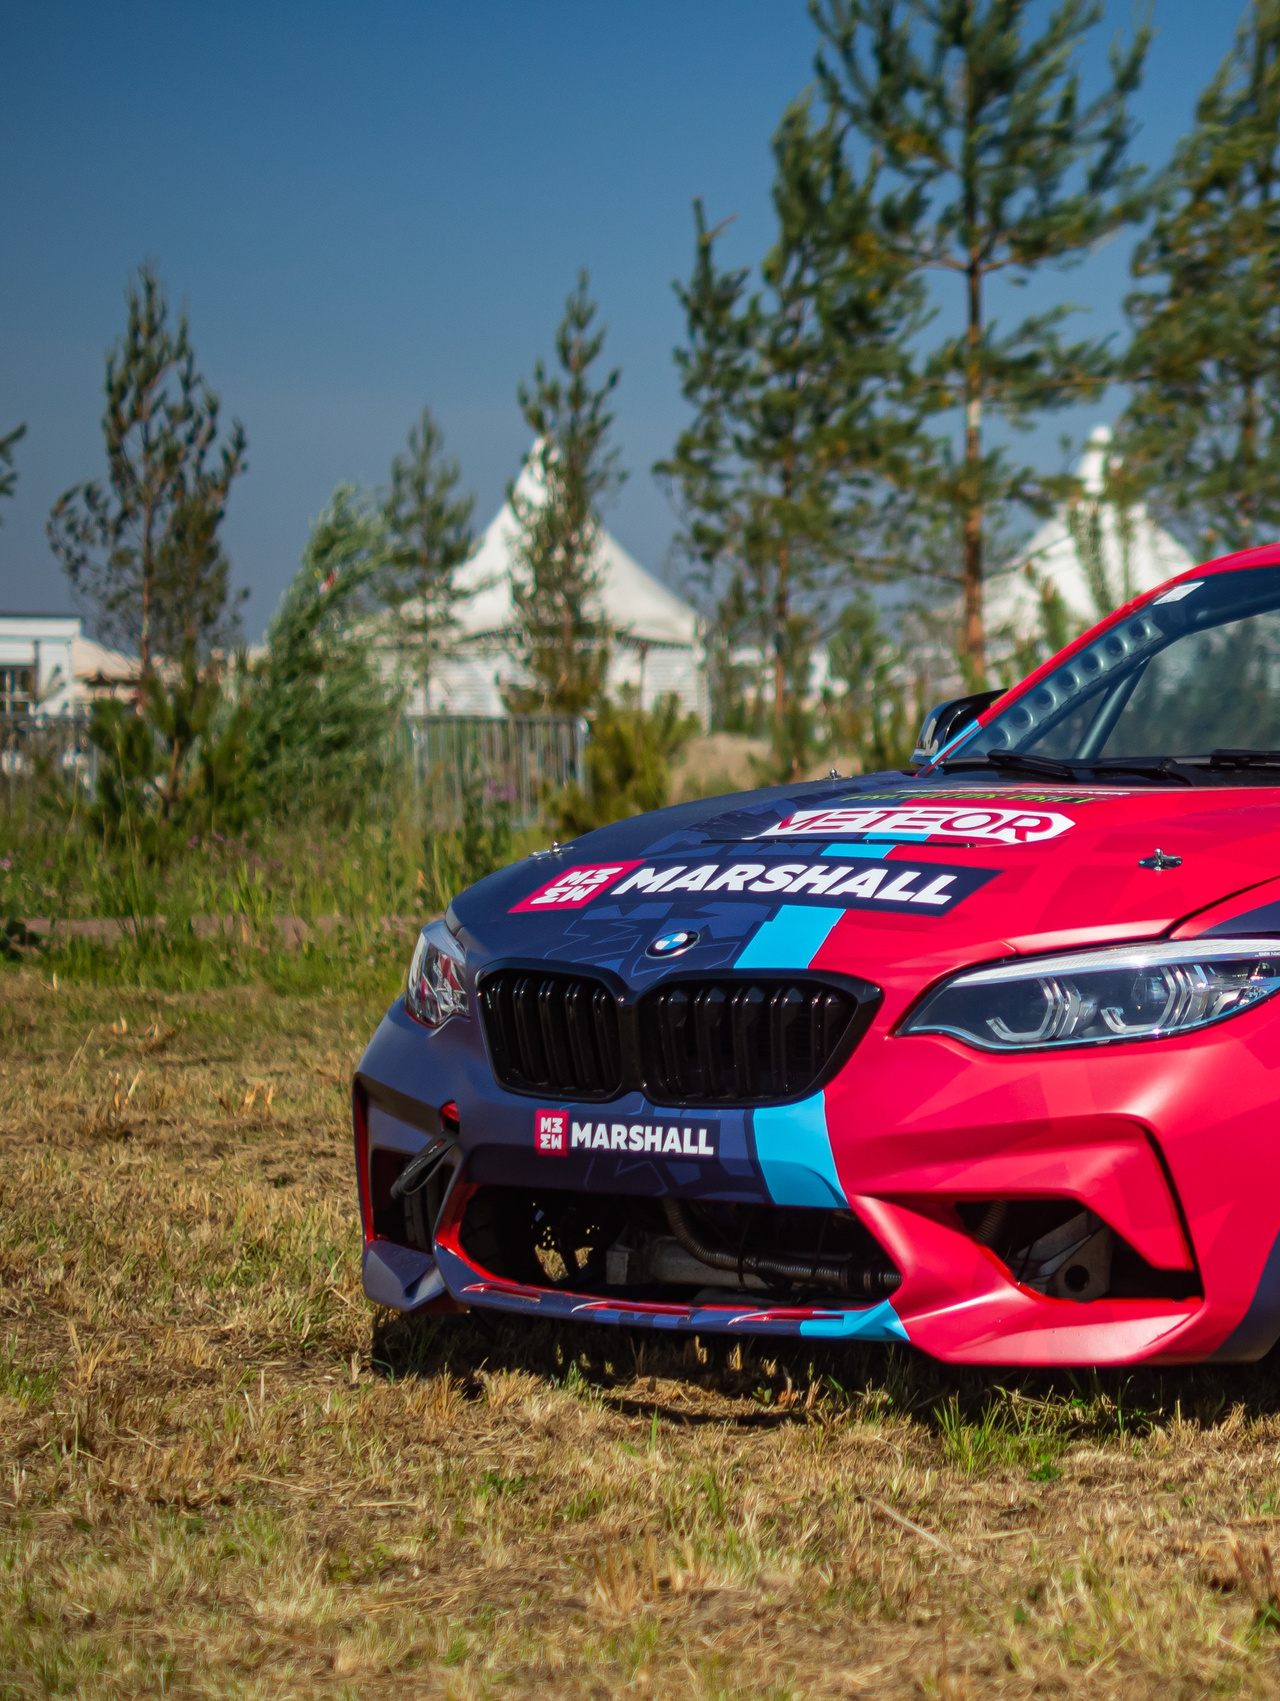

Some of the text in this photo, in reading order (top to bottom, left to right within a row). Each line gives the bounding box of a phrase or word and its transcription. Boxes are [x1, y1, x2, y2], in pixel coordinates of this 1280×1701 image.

[777, 810, 1054, 841] METEOR
[611, 863, 958, 905] MARSHALL
[571, 1122, 714, 1155] MARSHALL
